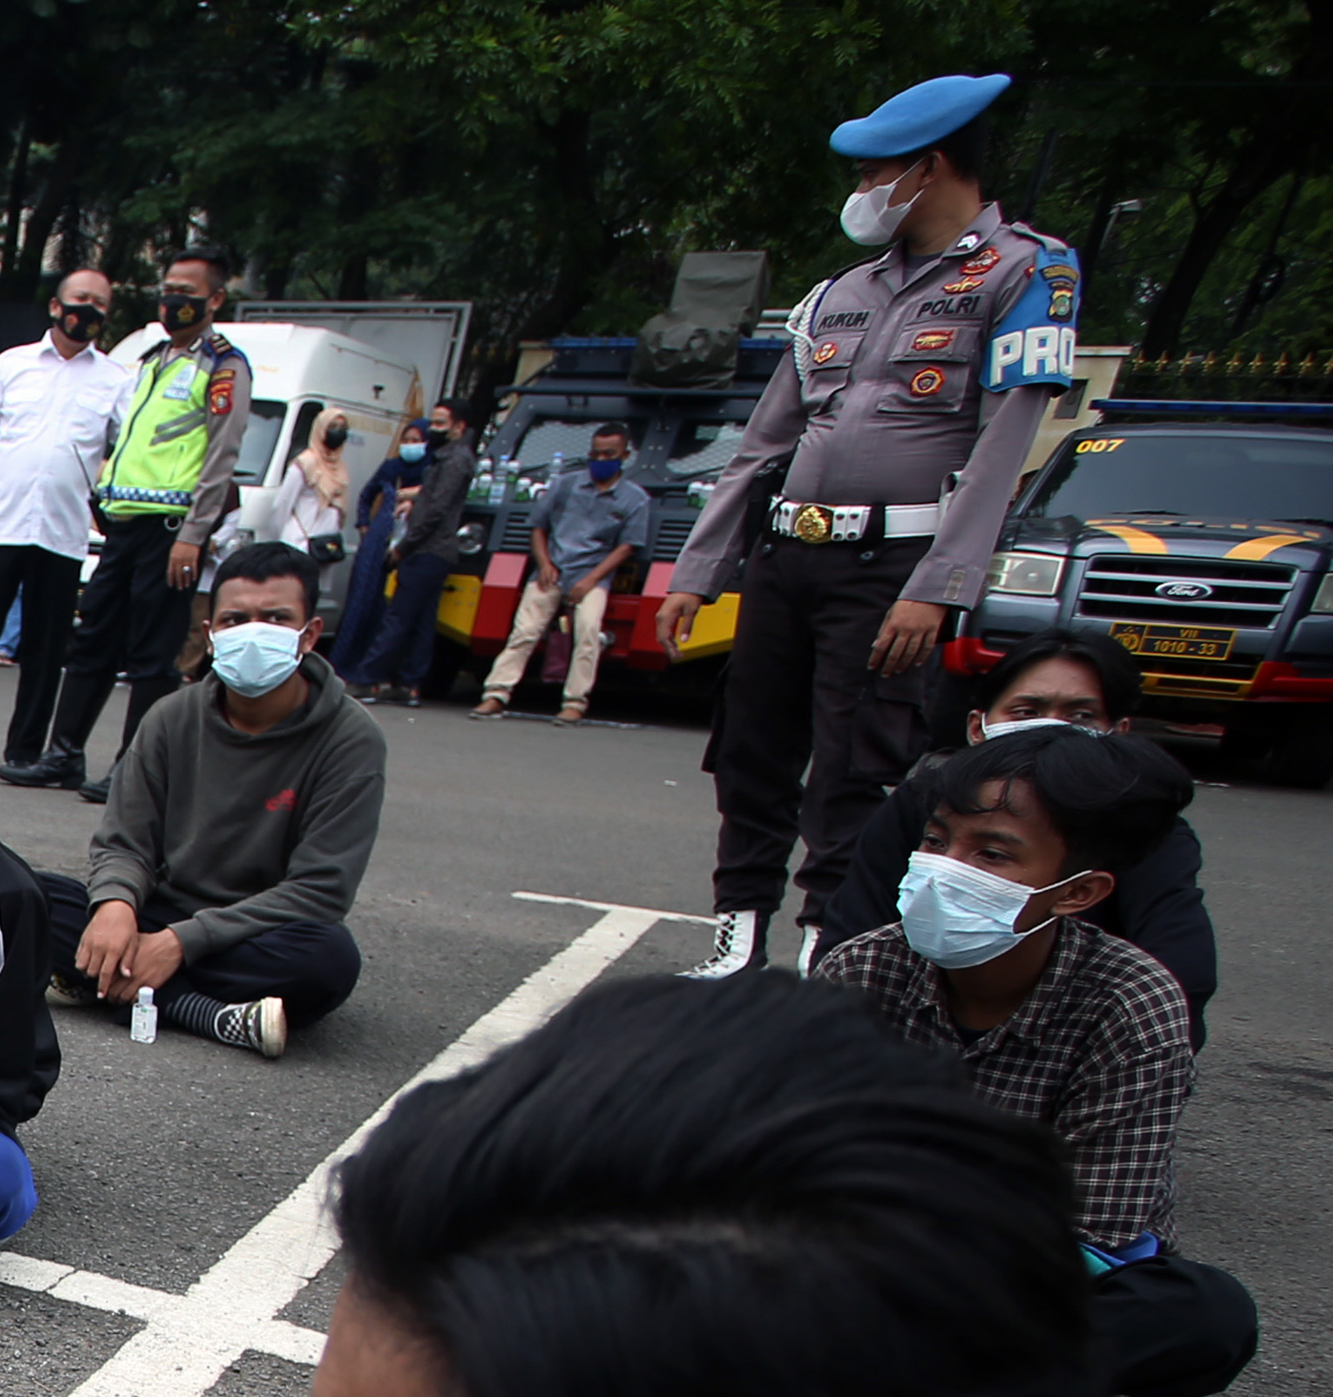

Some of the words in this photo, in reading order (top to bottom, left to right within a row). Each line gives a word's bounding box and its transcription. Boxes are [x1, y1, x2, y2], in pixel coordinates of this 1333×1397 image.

[916, 296, 981, 318] POLRI
[818, 311, 869, 330] KUKUH
[1076, 438, 1126, 453] 007
[1166, 584, 1200, 597] Ford
[1153, 640, 1184, 654] 1010
[1198, 643, 1217, 656] 33
